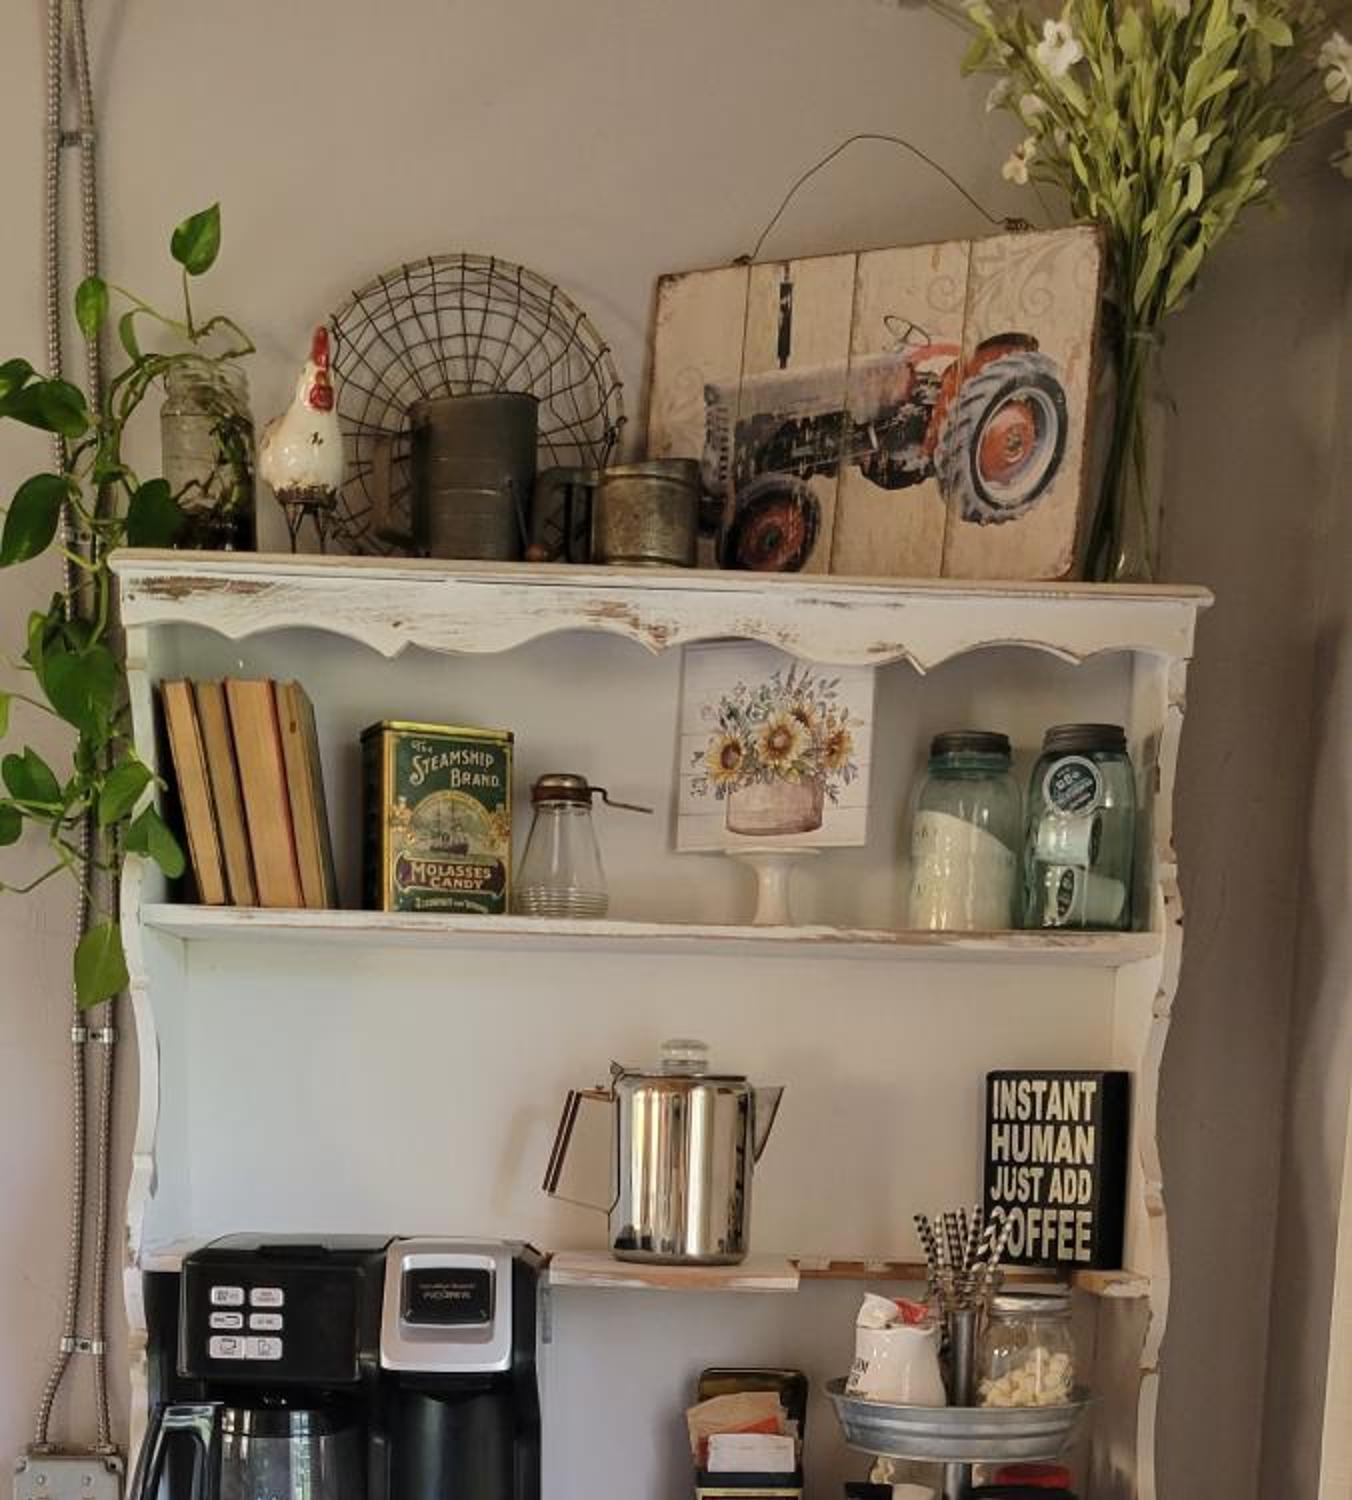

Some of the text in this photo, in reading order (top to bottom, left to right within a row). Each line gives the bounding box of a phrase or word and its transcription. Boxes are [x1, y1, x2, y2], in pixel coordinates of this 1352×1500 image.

[410, 750, 495, 785] STEAMSHIP
[451, 768, 499, 788] BRAND
[411, 861, 492, 882] MOLASSES
[431, 877, 484, 889] CANDY
[993, 1079, 1097, 1122] INSTANT
[991, 1123, 1095, 1165] HUMAN
[991, 1166, 1093, 1205] JUST ADD
